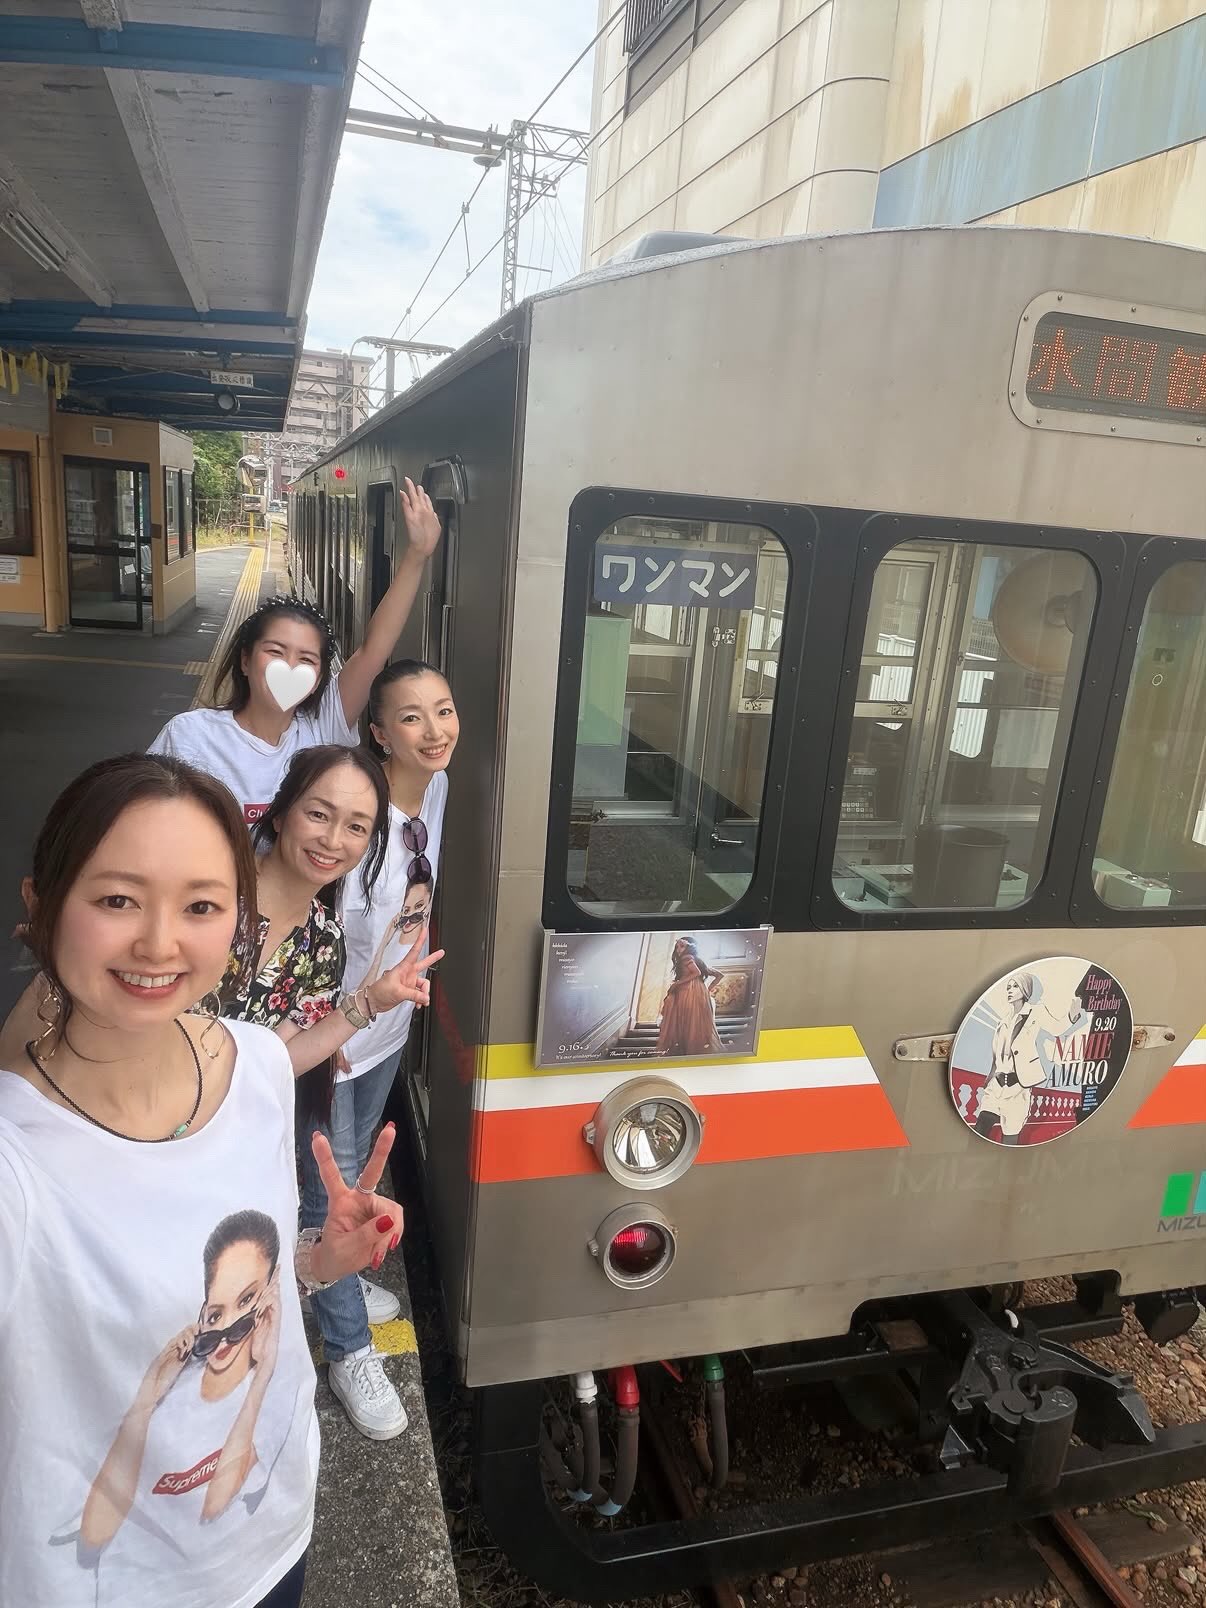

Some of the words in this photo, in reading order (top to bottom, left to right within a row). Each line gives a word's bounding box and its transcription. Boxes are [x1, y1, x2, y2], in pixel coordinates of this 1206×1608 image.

[602, 554, 751, 598] ワンマン
[1085, 974, 1114, 995] Happy
[1086, 993, 1123, 1015] Birthday
[1094, 1016, 1117, 1032] 9.20
[1052, 1031, 1115, 1061] NAMIE
[1045, 1060, 1109, 1088] AMURO
[159, 1457, 218, 1492] Supreme
